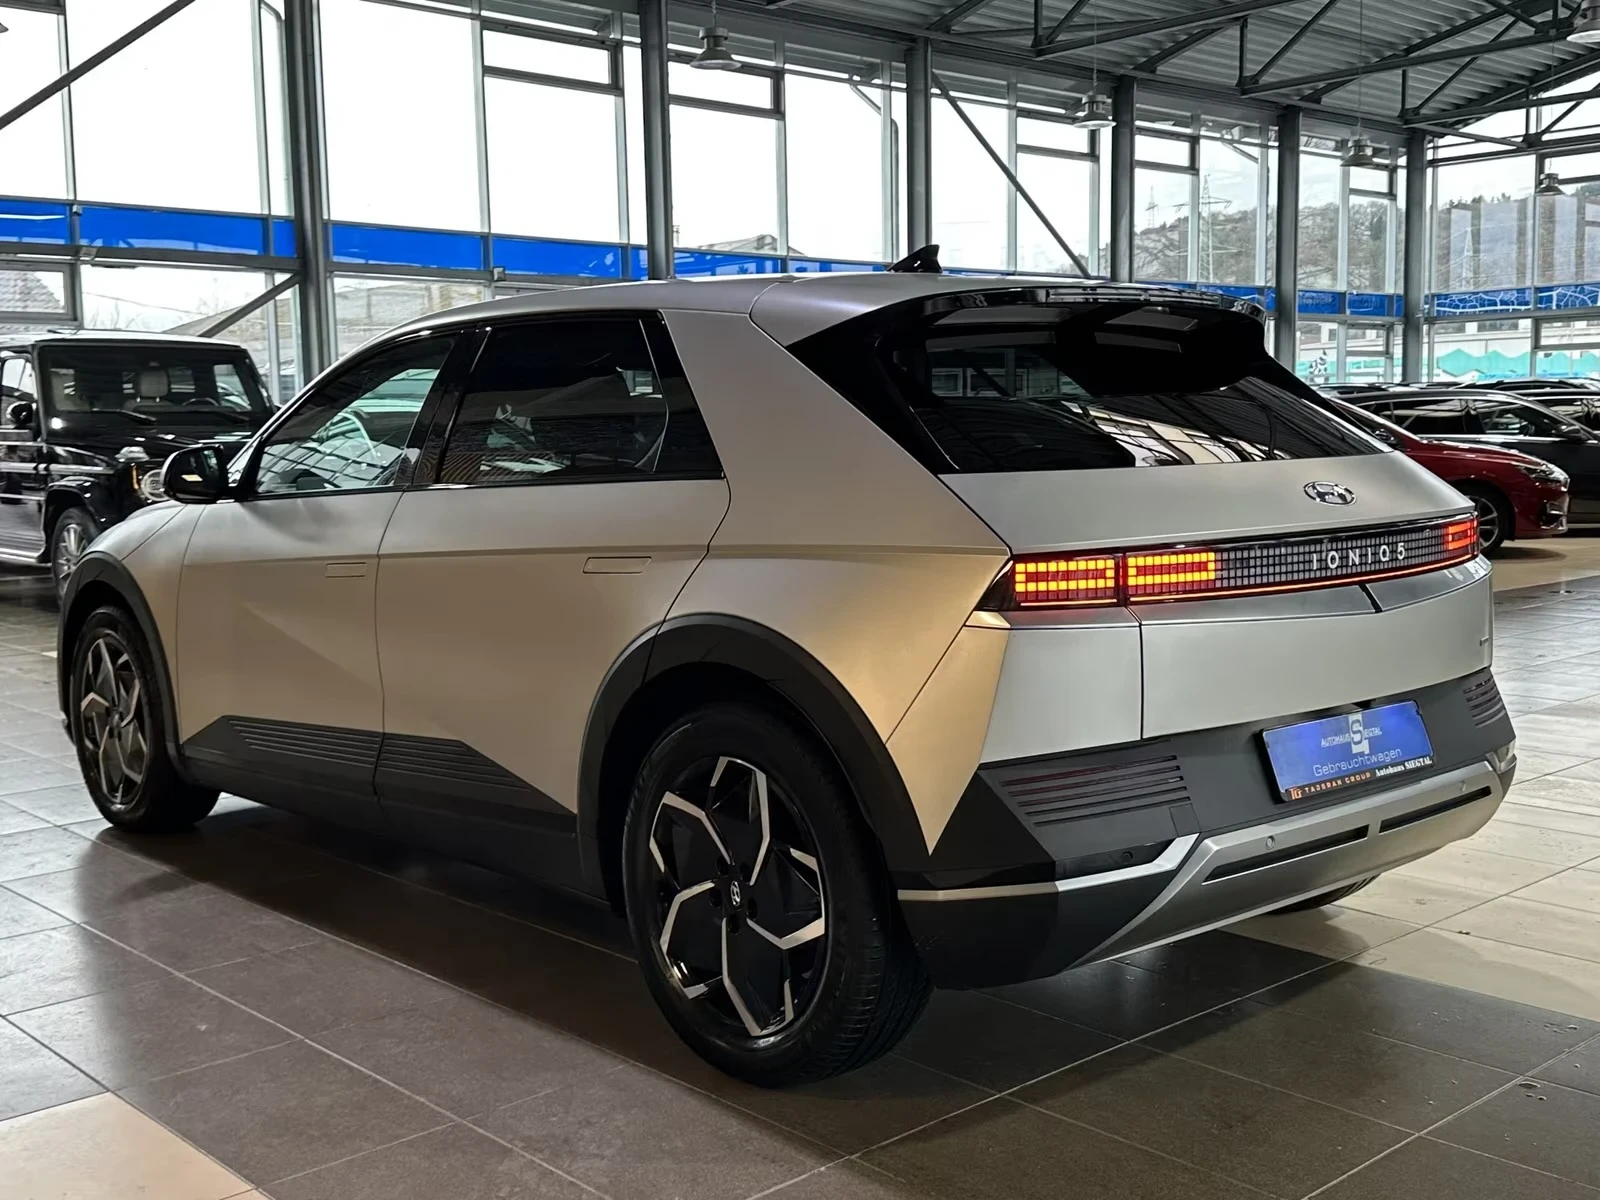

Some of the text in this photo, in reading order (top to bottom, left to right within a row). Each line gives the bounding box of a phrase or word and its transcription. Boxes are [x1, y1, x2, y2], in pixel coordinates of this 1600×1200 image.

[1320, 733, 1351, 748] AUTOHAUS
[1312, 747, 1402, 777] Gebrauchtwagen
[1375, 756, 1433, 777] Autohaus SIEGTAL
[1345, 772, 1371, 784] GROUP
